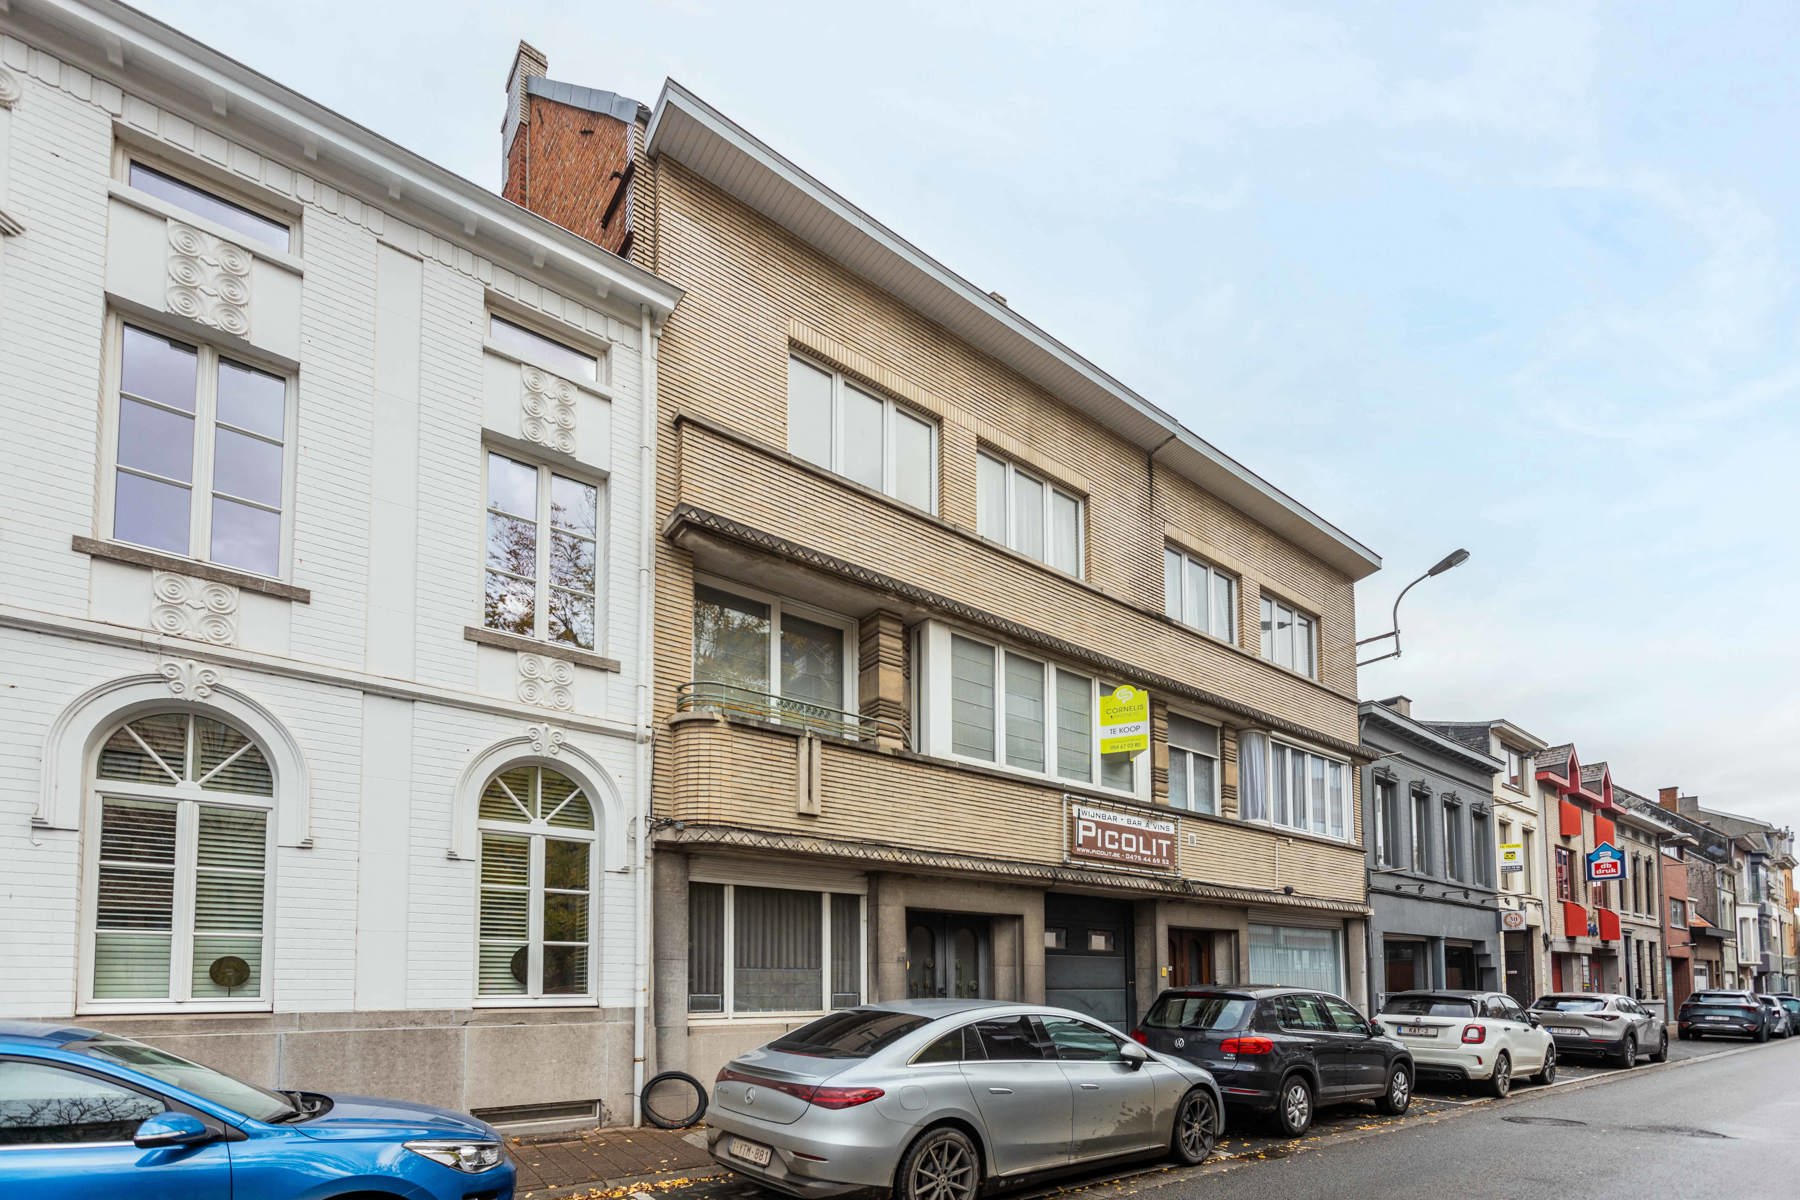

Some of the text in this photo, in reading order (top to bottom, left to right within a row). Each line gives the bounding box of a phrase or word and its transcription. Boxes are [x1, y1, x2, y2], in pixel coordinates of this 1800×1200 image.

[1106, 704, 1144, 715] CORNELIS
[1119, 725, 1141, 734] KOOP
[1081, 809, 1118, 822] WIJNBAR
[1126, 819, 1142, 827] BAR
[1077, 820, 1171, 857] PICOLIT
